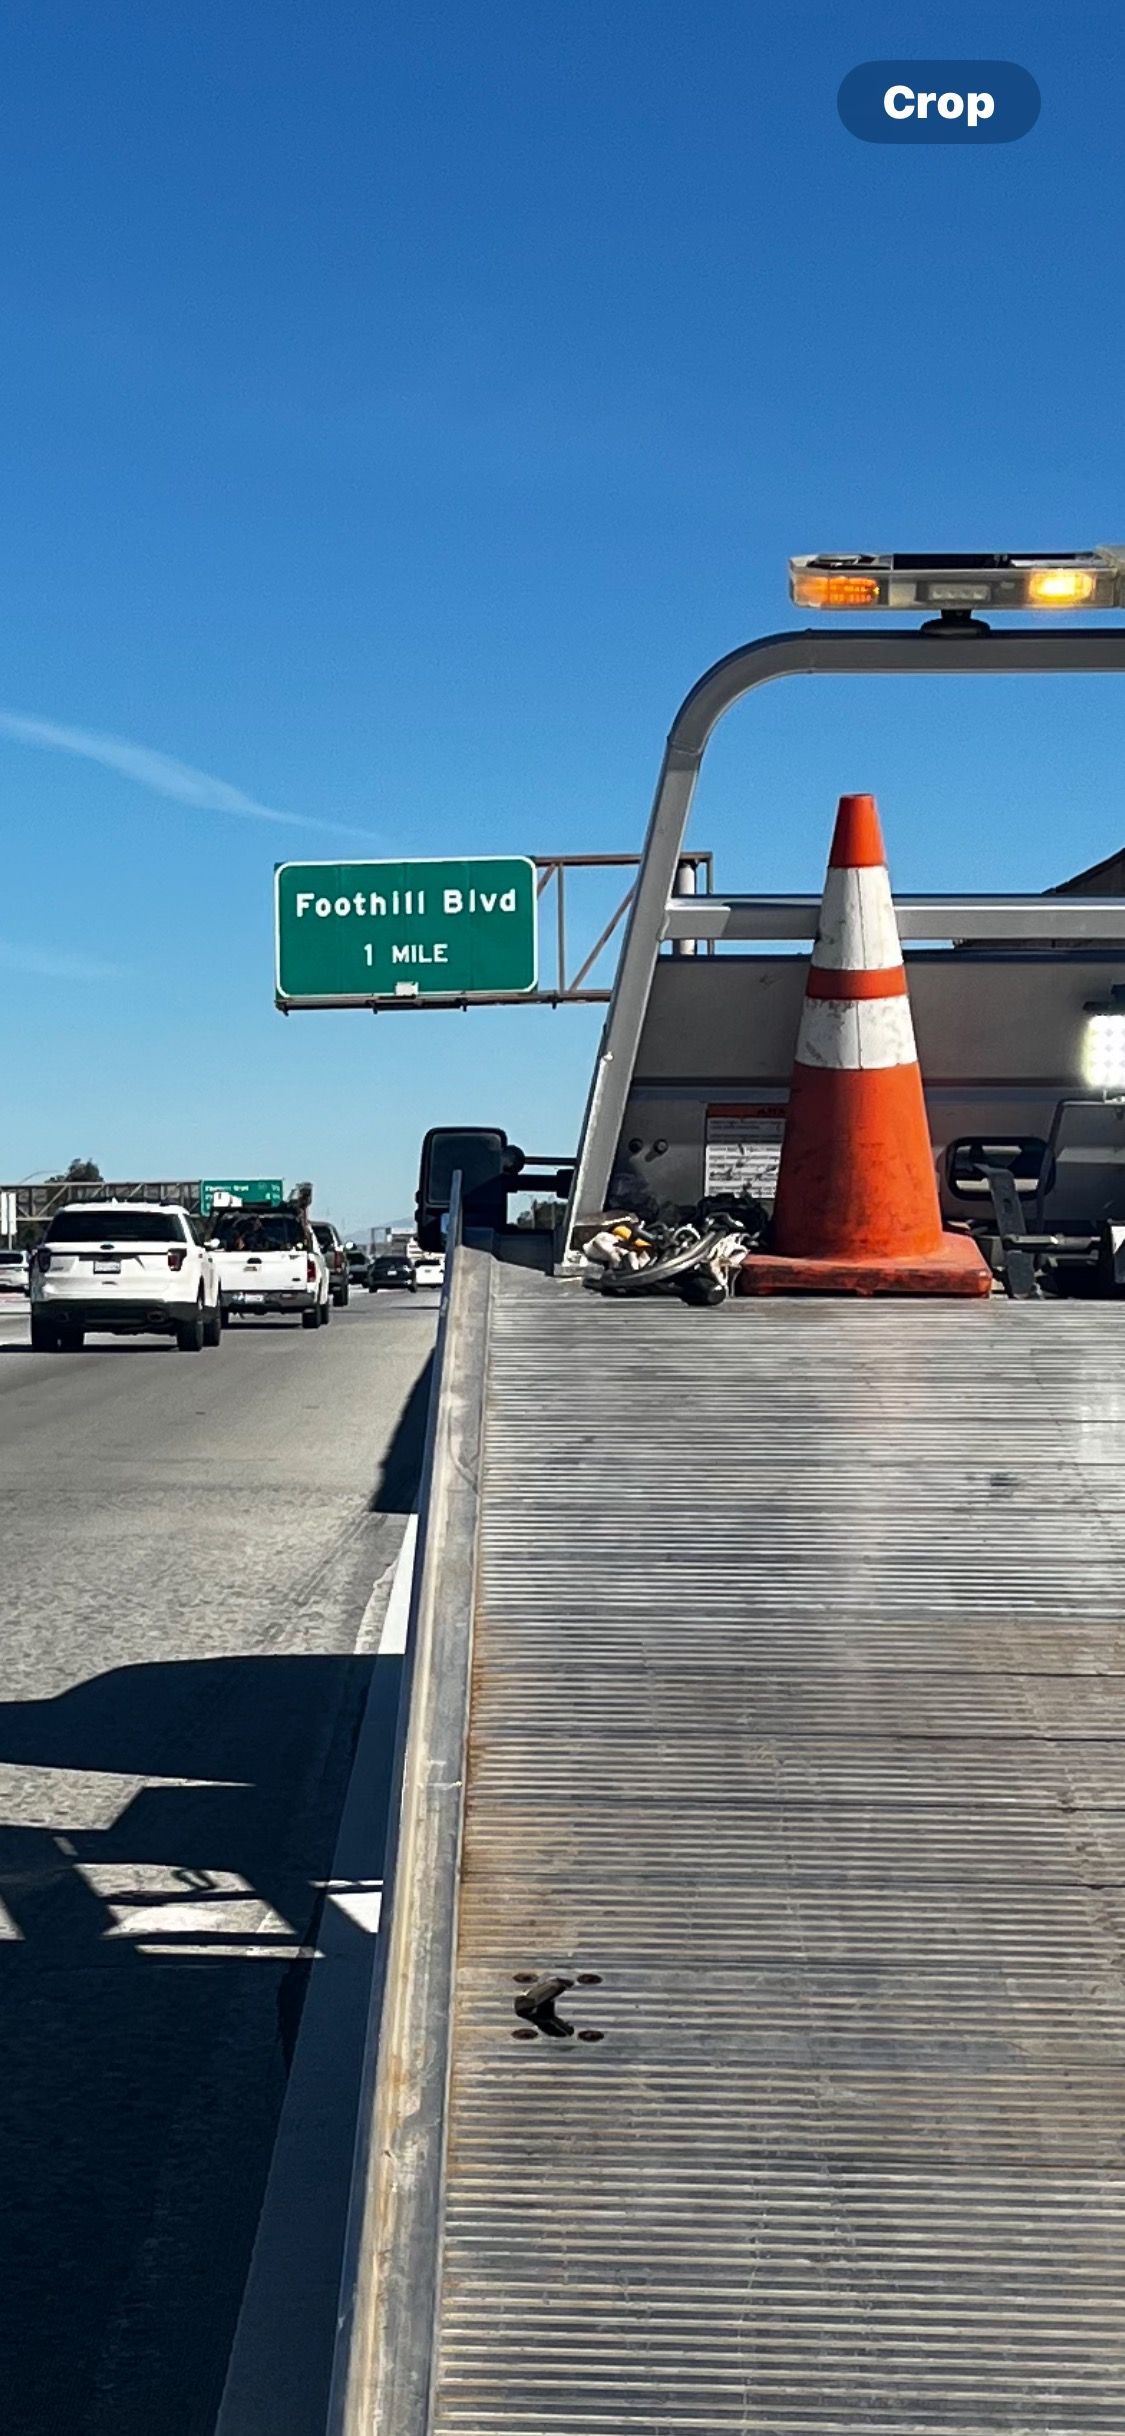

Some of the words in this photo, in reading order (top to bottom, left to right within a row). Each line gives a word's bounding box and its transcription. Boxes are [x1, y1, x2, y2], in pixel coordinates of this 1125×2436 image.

[296, 890, 425, 918] Foothill
[443, 888, 517, 914] Blvd
[364, 943, 374, 967] 1
[392, 943, 449, 964] MILE
